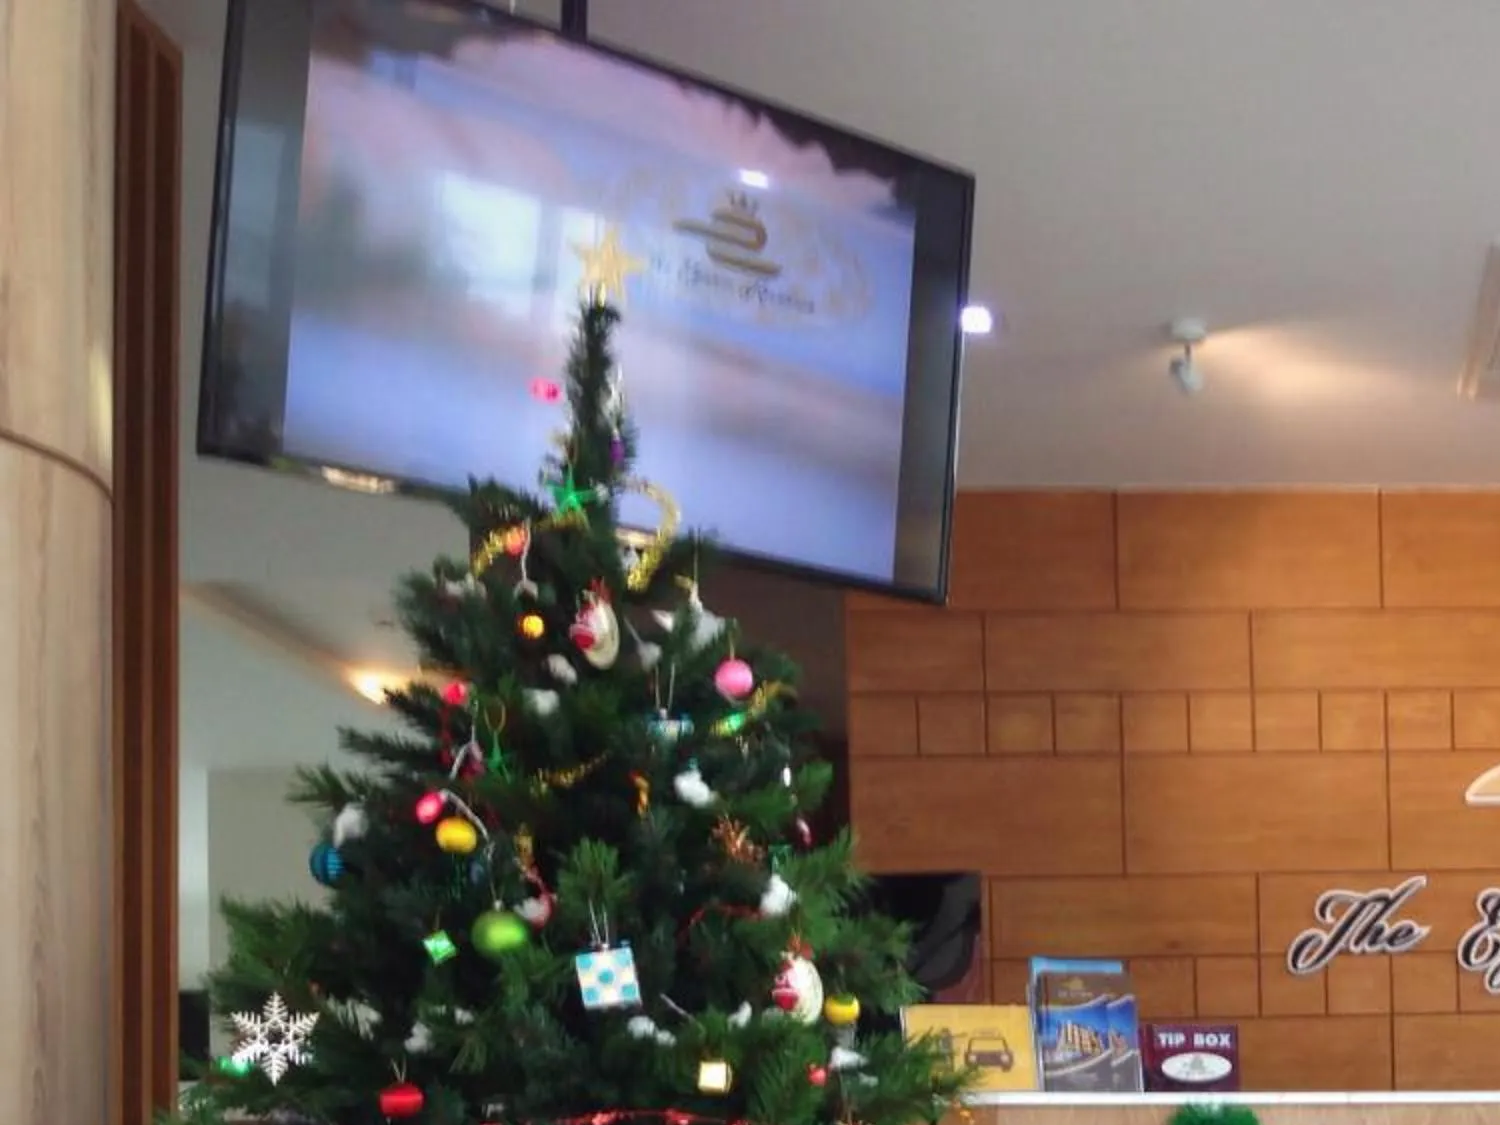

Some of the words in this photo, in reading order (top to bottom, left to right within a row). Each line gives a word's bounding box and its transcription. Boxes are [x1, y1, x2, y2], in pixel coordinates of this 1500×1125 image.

[1288, 875, 1432, 975] The
[1158, 1031, 1186, 1049] TIP
[1193, 1031, 1231, 1049] BOX
